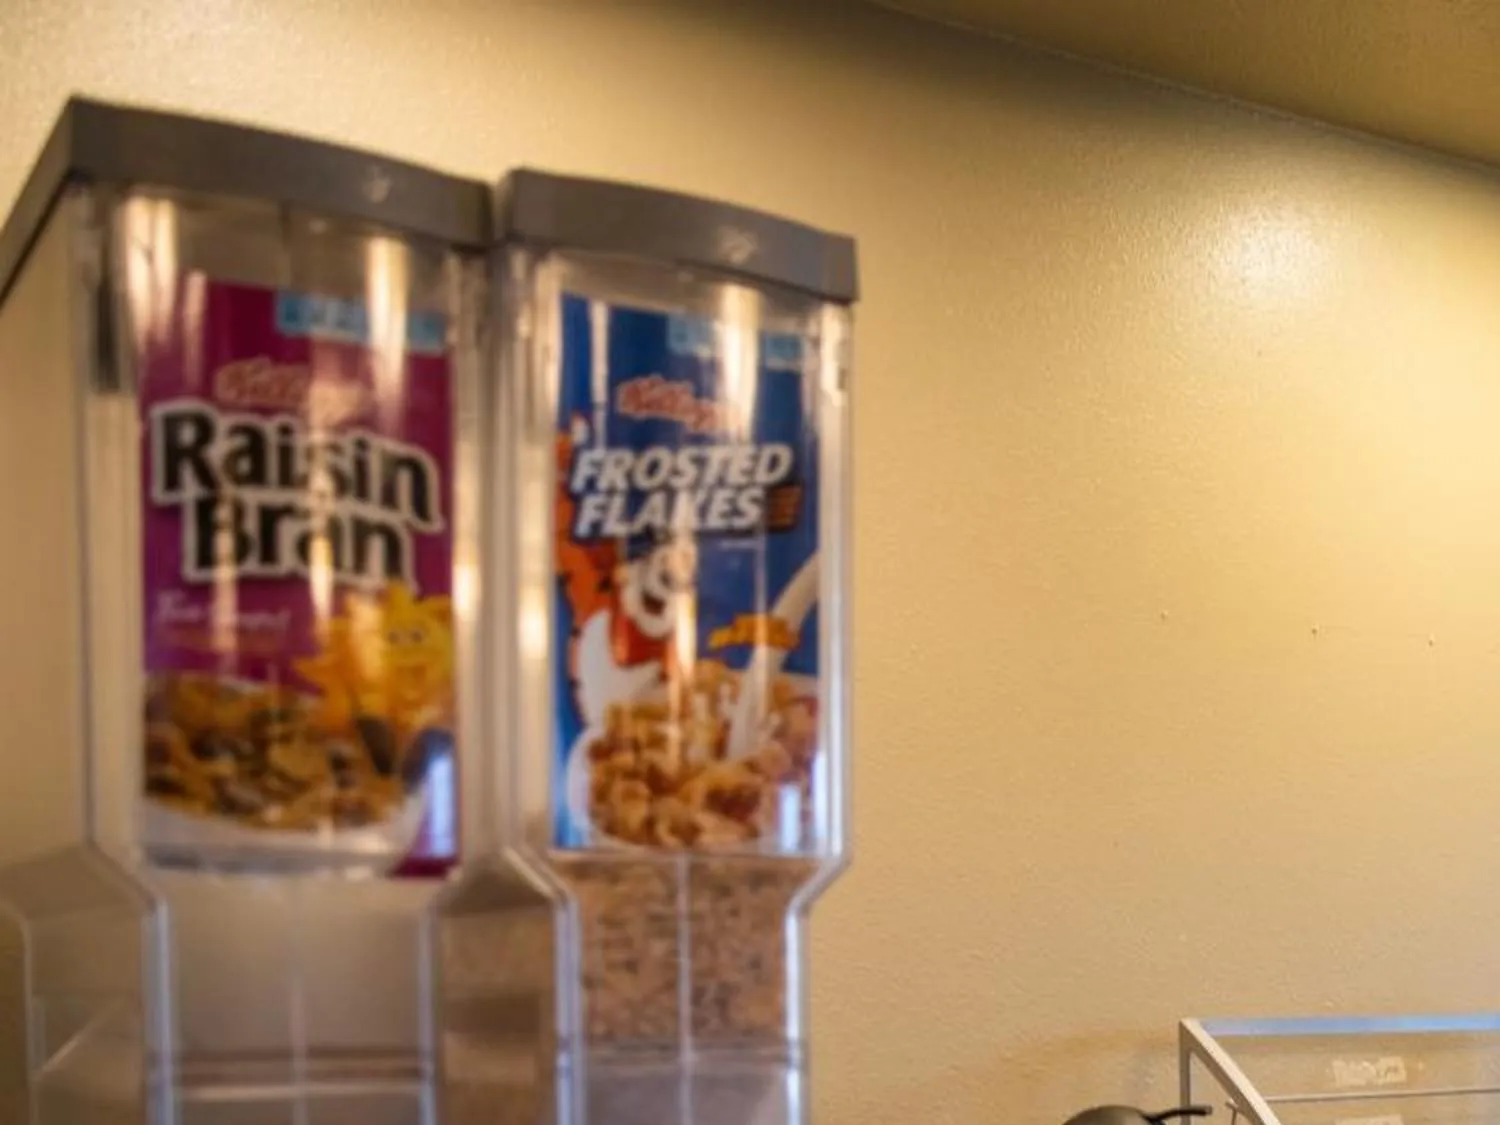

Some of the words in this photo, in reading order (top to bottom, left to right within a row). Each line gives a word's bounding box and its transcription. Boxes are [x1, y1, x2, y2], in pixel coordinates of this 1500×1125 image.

[155, 400, 440, 529] Raisin
[570, 444, 794, 492] FROSTED
[186, 494, 412, 586] Bran
[575, 488, 765, 538] FLAKES
